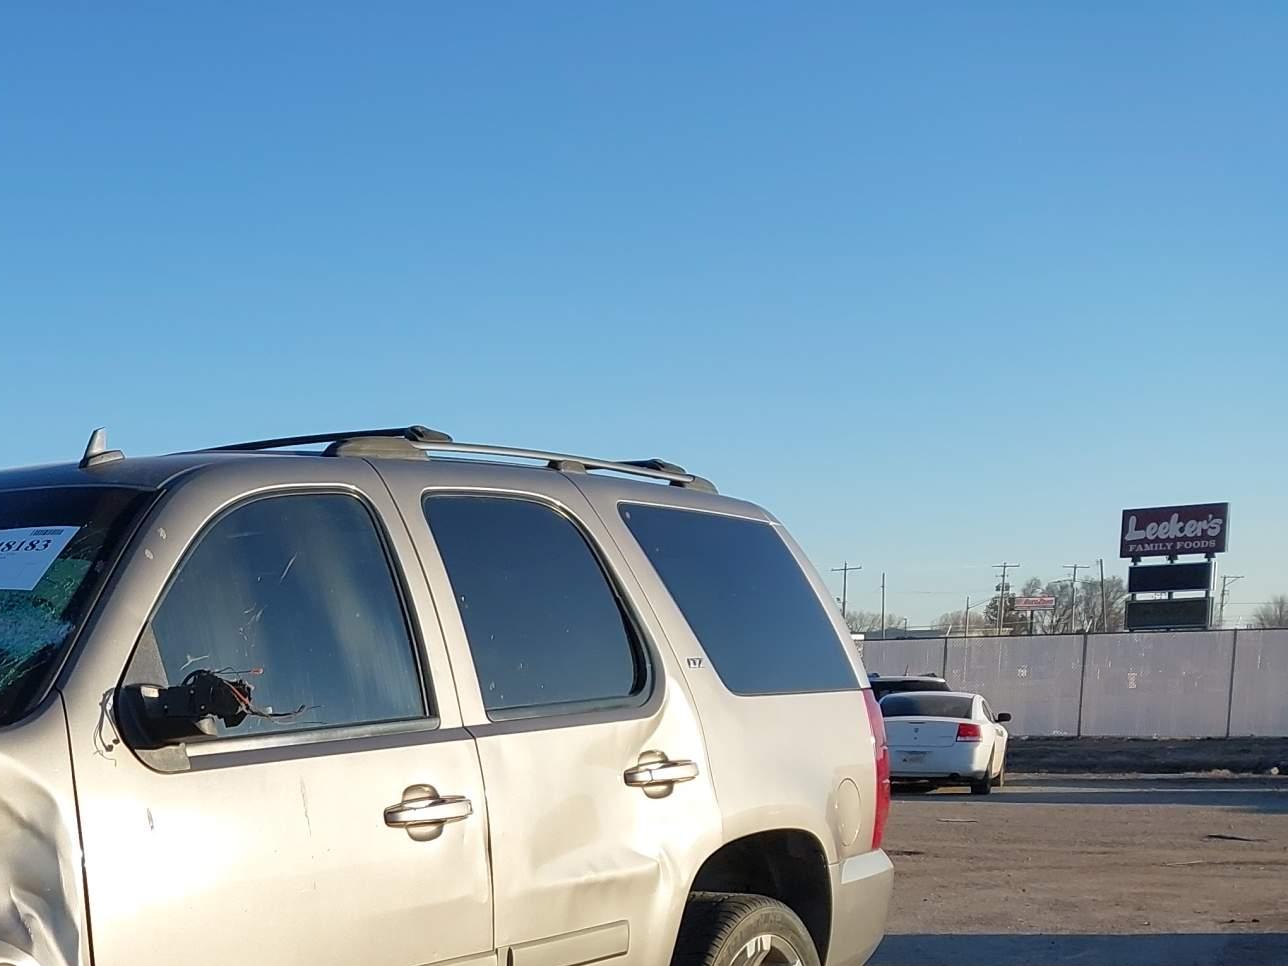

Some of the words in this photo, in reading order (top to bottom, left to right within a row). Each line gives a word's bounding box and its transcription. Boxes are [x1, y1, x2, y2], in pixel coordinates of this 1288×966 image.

[1124, 511, 1224, 541] Leeker's
[1128, 542, 1174, 552] FAMILY
[1176, 539, 1217, 550] FOODS
